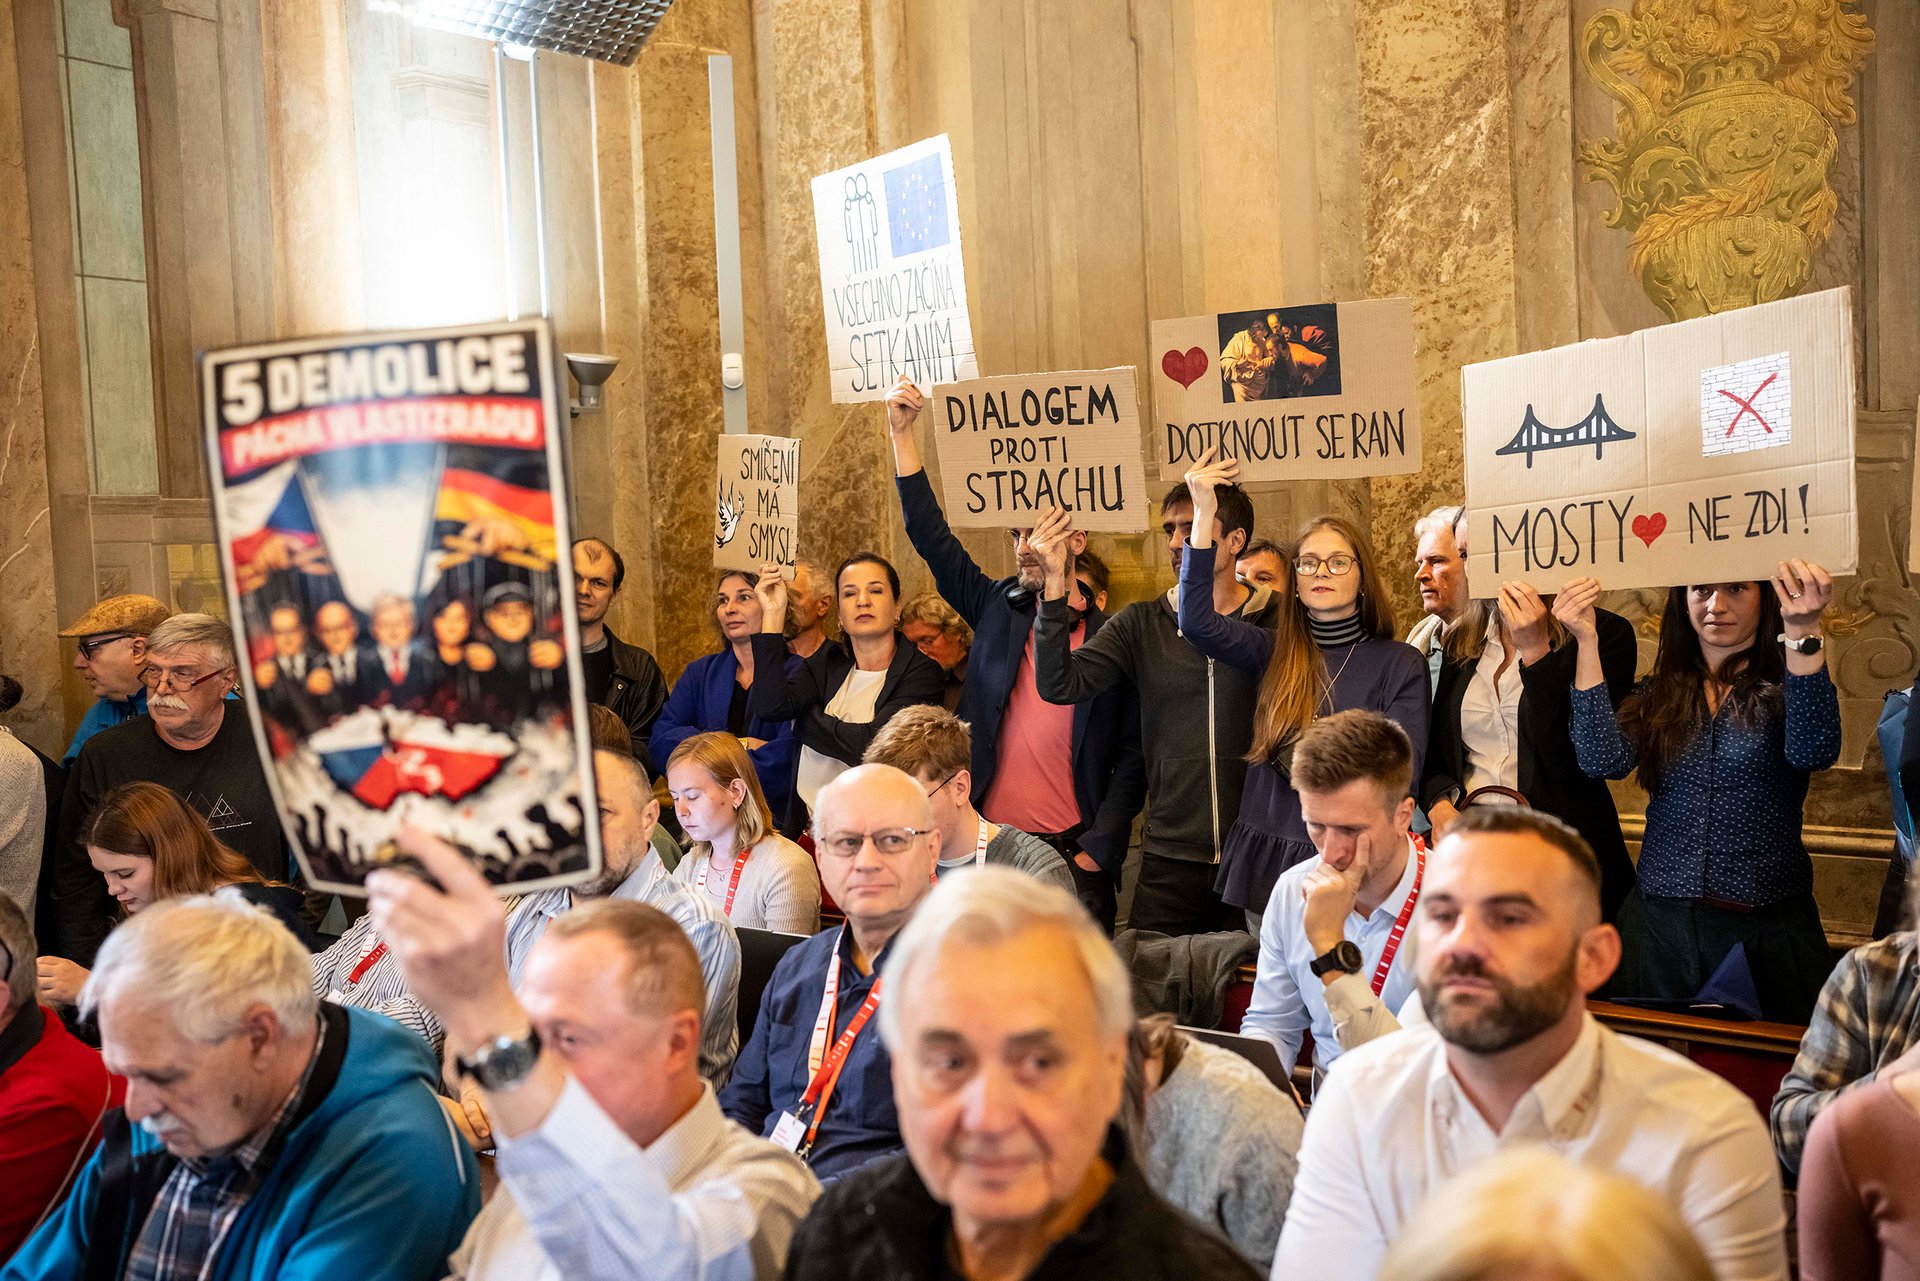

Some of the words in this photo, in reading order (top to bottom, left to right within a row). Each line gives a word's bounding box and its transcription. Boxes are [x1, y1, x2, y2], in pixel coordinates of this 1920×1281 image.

[833, 272, 902, 328] VŠECHNO
[849, 310, 958, 392] SETKÁNÍM
[222, 361, 264, 427] 5
[266, 334, 531, 414] DEMOLICE
[326, 400, 538, 446] VLASTIZRADU
[946, 383, 1120, 433] DIALOGEM
[990, 435, 1068, 465] PROTI
[1166, 413, 1305, 465] DOTKNOUT
[1316, 413, 1346, 460] SE
[1351, 408, 1406, 460] RAN
[740, 438, 797, 486] SMÍŘENÍ
[757, 484, 780, 519] MÁ
[966, 464, 1125, 514] STRACHU
[748, 522, 795, 567] SMYSL
[1493, 494, 1635, 574] MOSTY
[1688, 494, 1732, 545] NE
